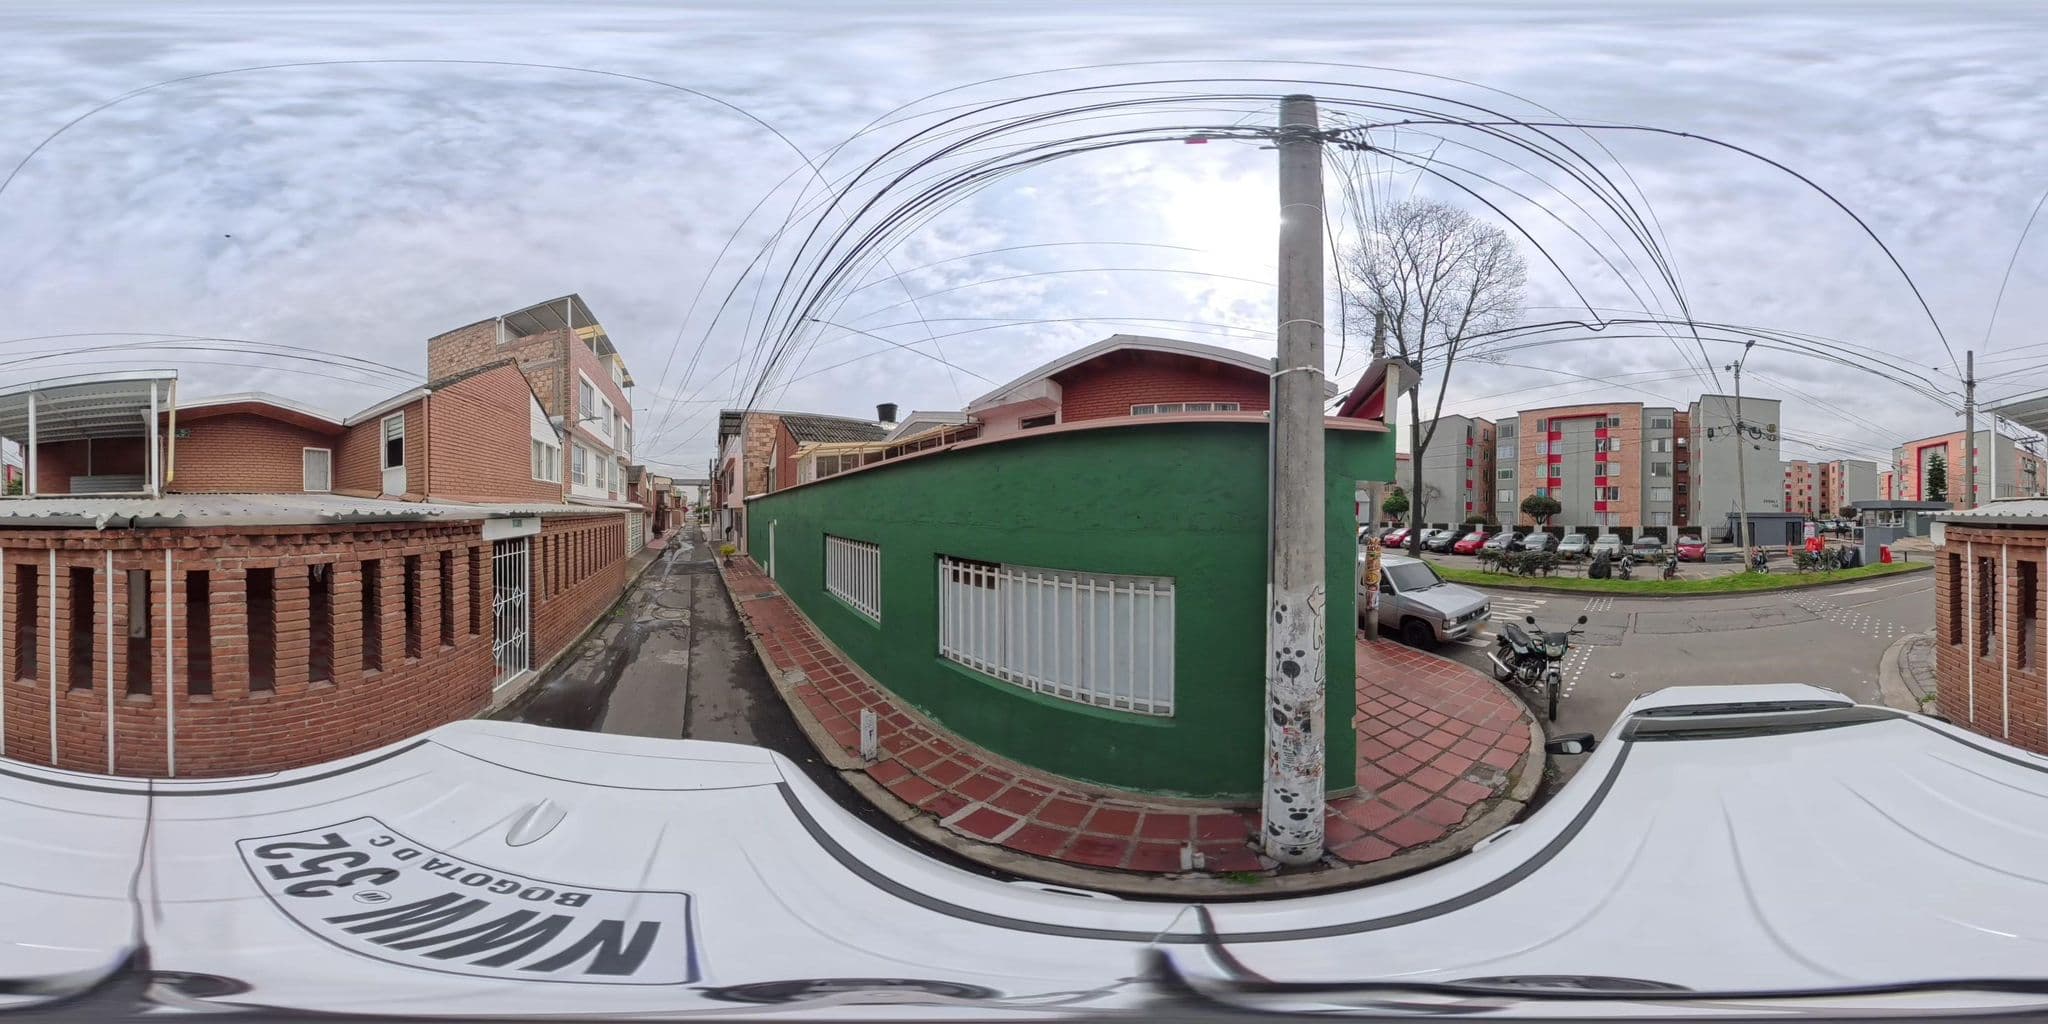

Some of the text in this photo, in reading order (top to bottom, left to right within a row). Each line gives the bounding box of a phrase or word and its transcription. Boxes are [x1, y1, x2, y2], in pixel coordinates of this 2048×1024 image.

[253, 832, 662, 976] NWW 352
[419, 857, 593, 908] BOGOTA
